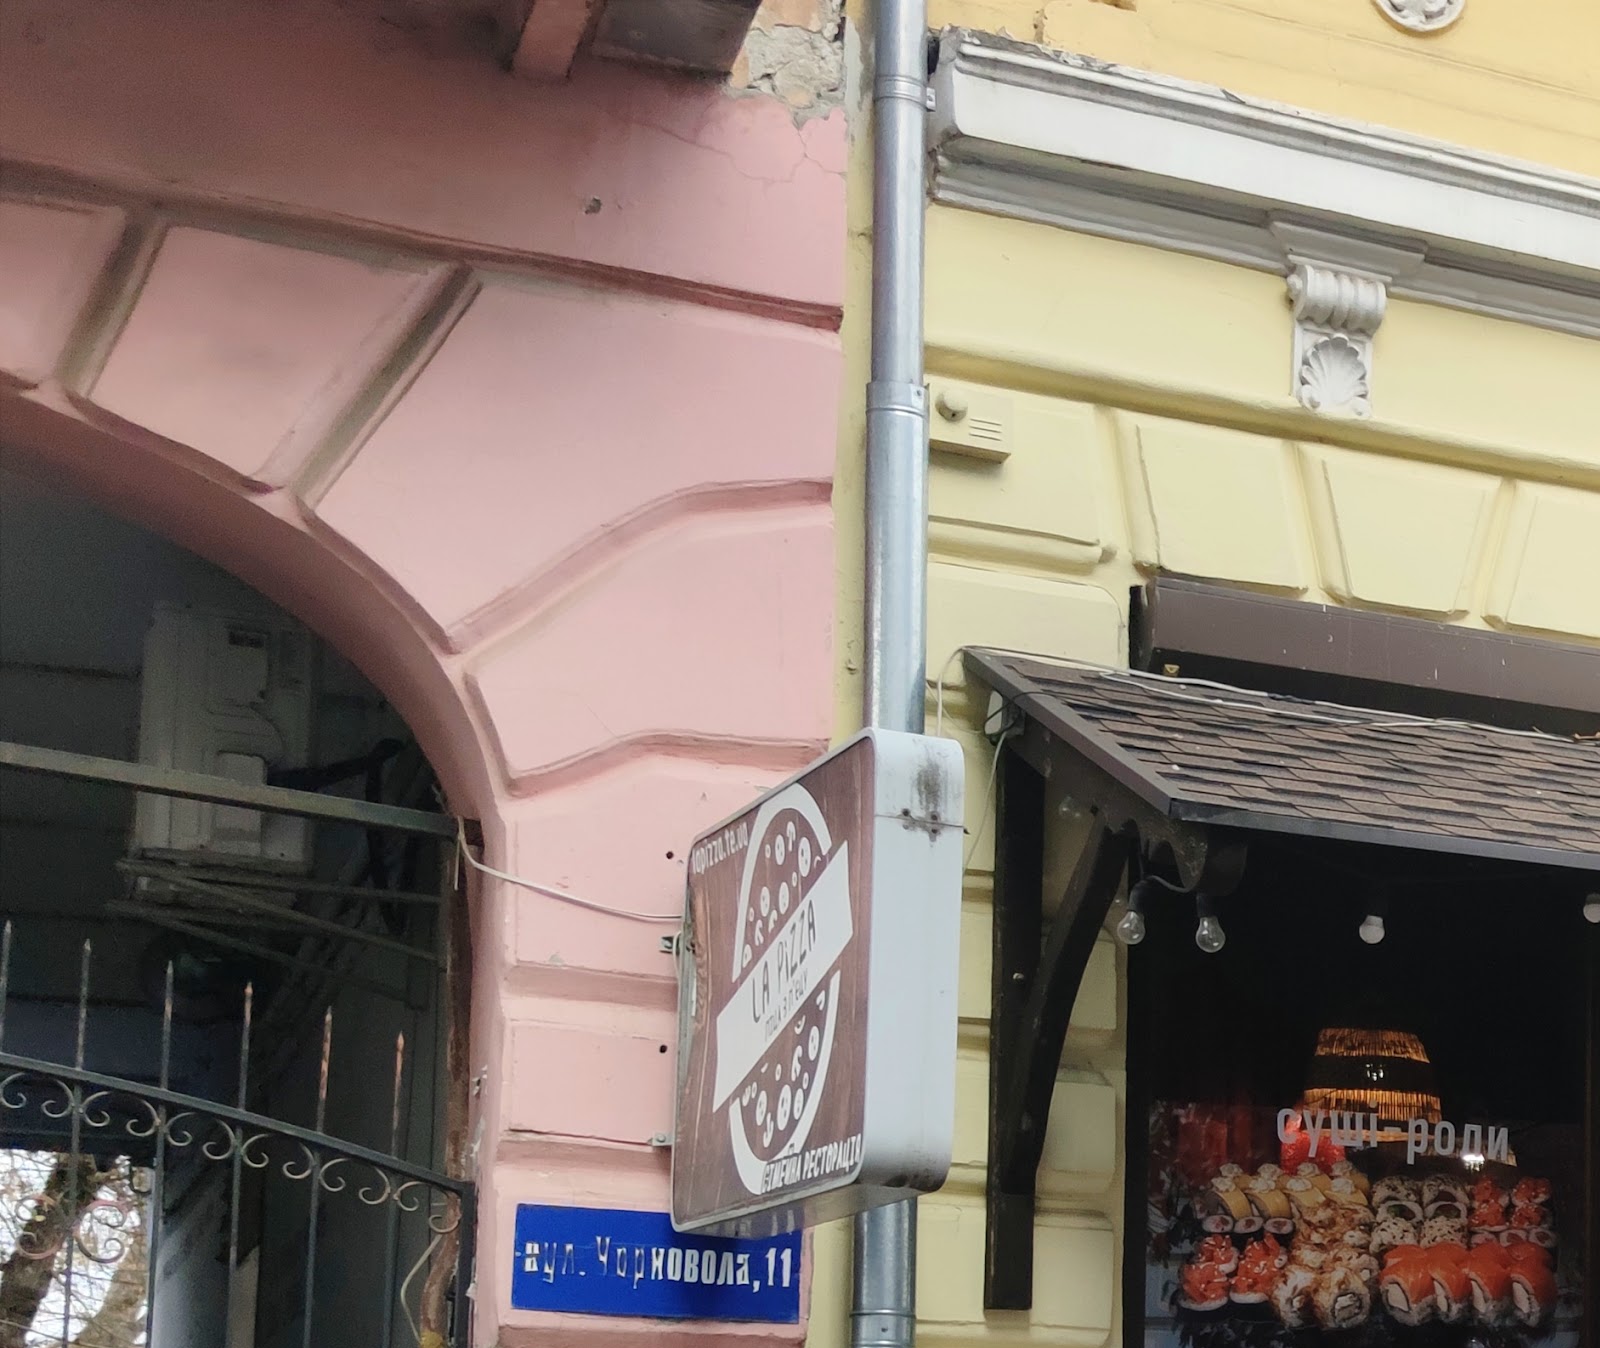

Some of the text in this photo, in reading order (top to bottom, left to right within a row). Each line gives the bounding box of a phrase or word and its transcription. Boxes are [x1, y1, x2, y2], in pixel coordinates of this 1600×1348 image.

[752, 960, 770, 1023] LA
[802, 1133, 861, 1180] РЕСТОРАЦІЯ
[524, 1242, 586, 1283] вул.
